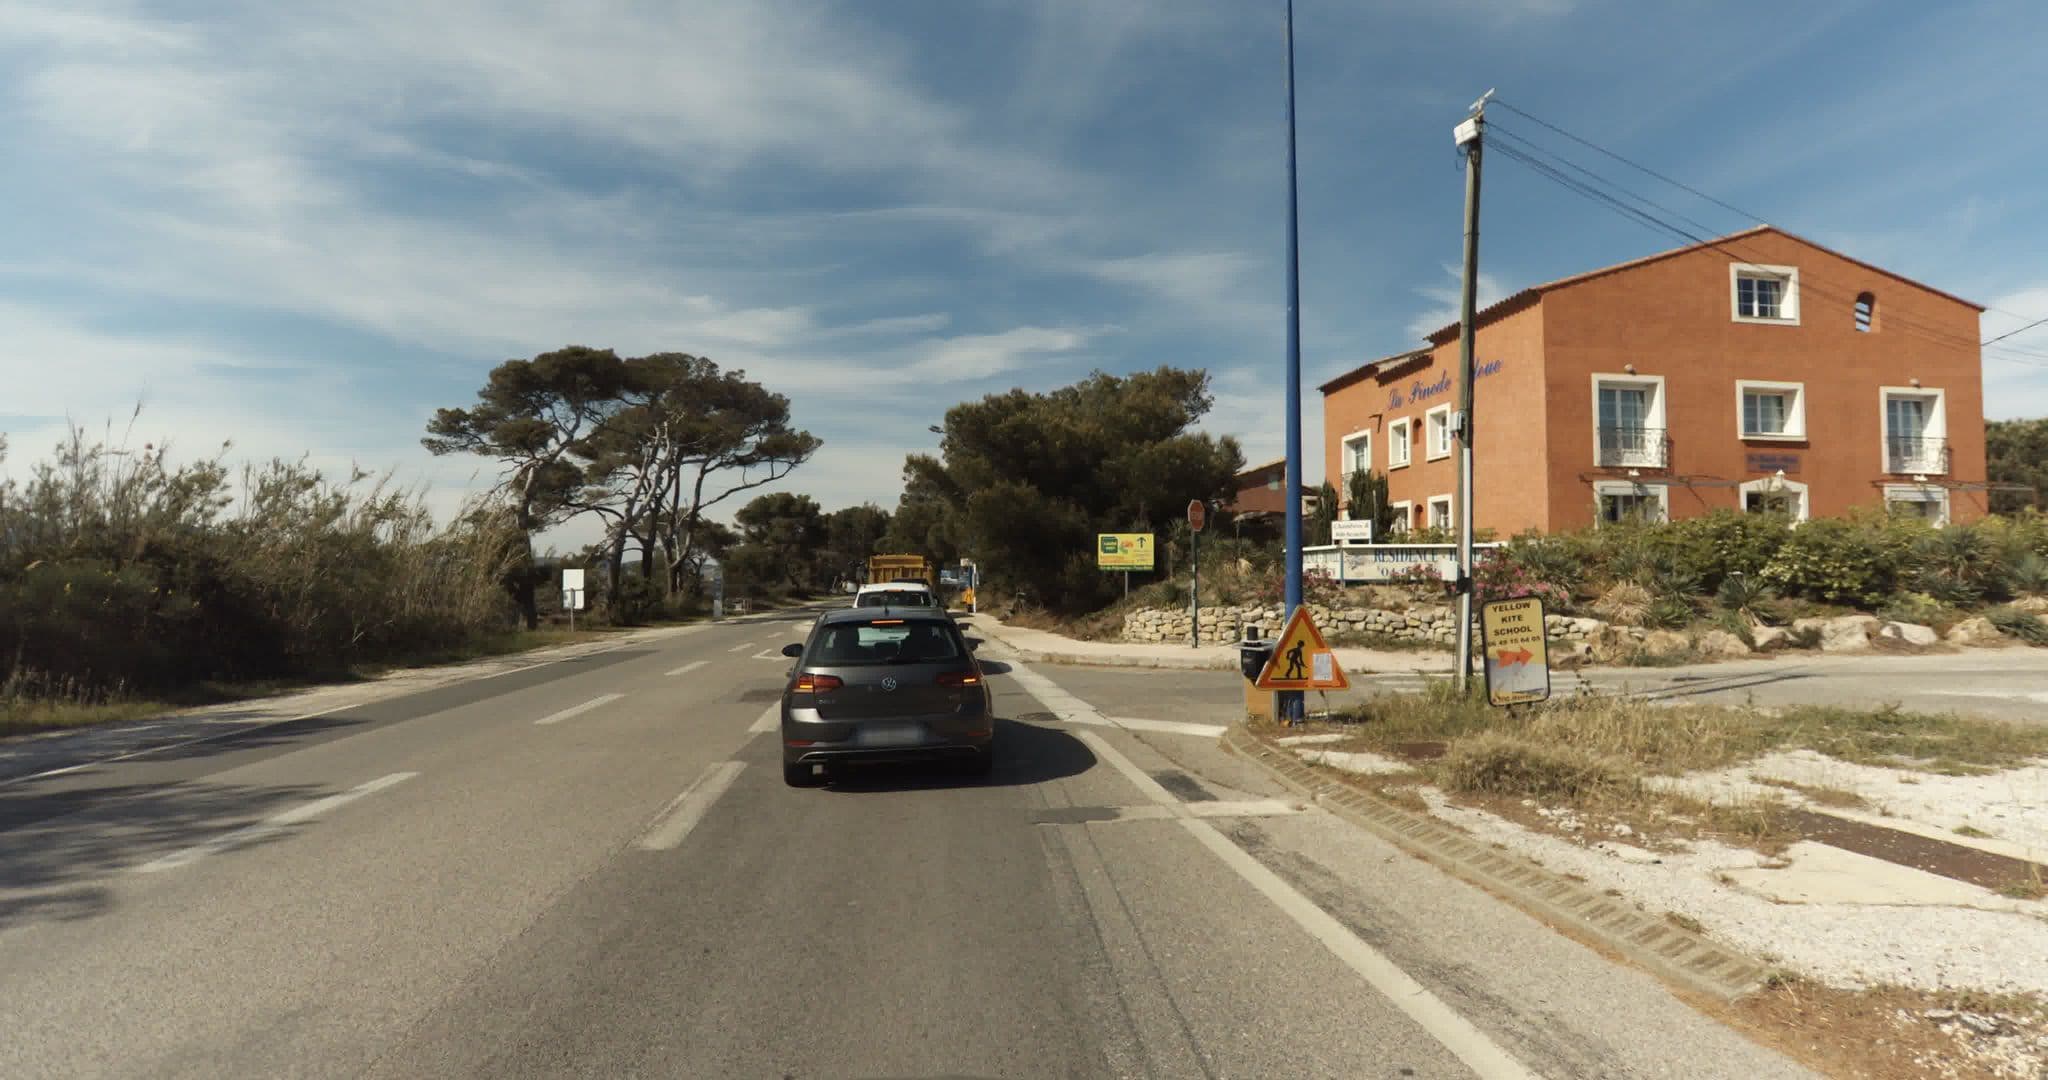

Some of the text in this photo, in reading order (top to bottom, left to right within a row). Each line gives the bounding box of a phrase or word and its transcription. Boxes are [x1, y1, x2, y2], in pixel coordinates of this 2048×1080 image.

[1492, 601, 1531, 613] YELLOW
[1501, 614, 1524, 624] KITE
[1493, 625, 1533, 637] SCHOOL
